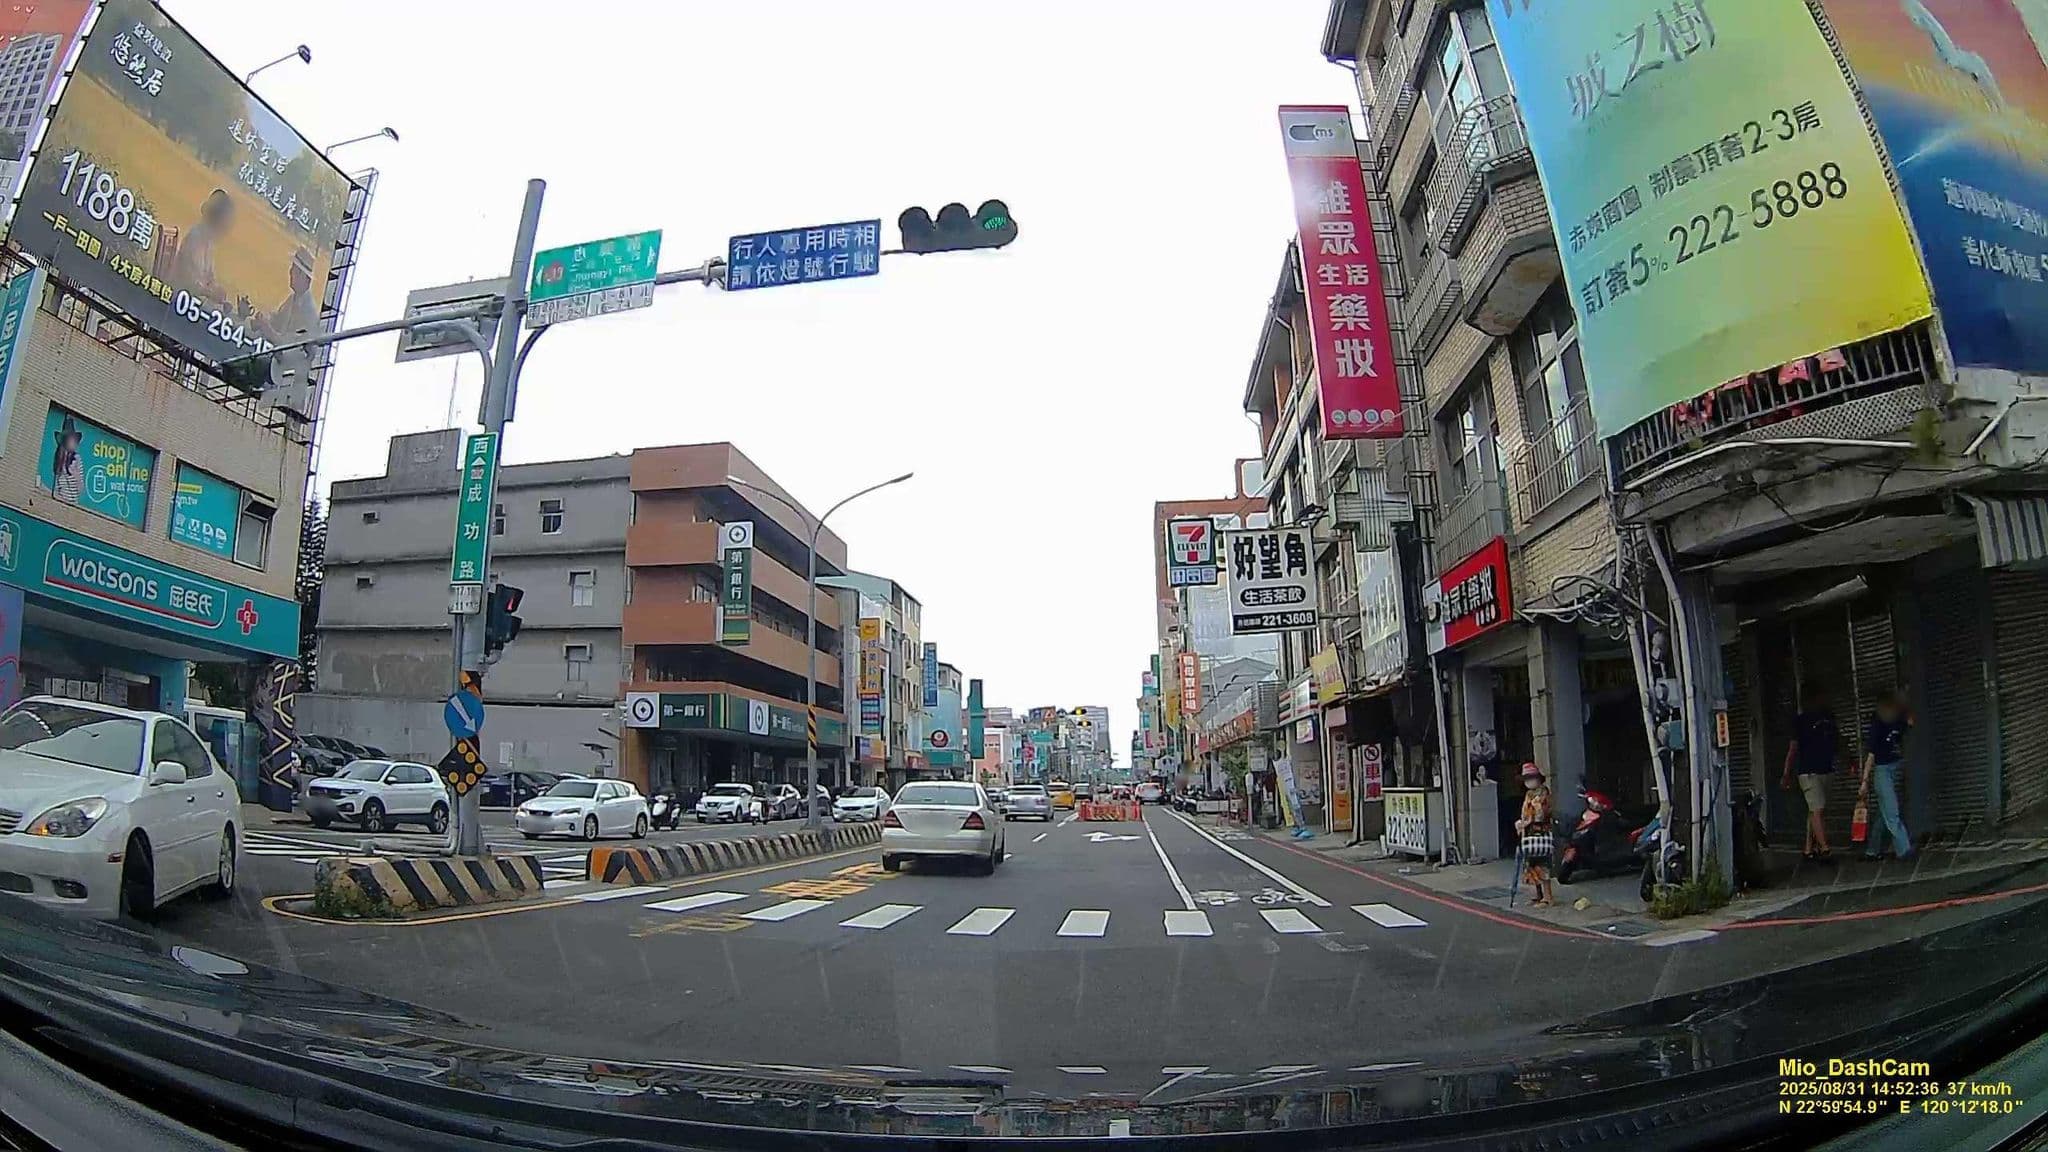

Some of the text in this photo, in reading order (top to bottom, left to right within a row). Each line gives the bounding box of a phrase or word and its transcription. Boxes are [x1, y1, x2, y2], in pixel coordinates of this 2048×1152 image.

[59, 150, 158, 250] 1188萬
[1669, 162, 1848, 265] 222-5888
[732, 224, 876, 260] 行人專用時相
[731, 249, 875, 289] 請依燈號行駛
[93, 440, 126, 463] shop
[473, 438, 489, 454] 西
[459, 484, 482, 578] 成功路
[731, 551, 743, 600] 第一銀行
[1233, 532, 1307, 580] 好望角
[61, 552, 213, 617] watsons 屈臣氏
[1244, 587, 1302, 605] 生活茶飲
[1262, 612, 1313, 626] 221-3608
[663, 704, 705, 718] 第一銀行
